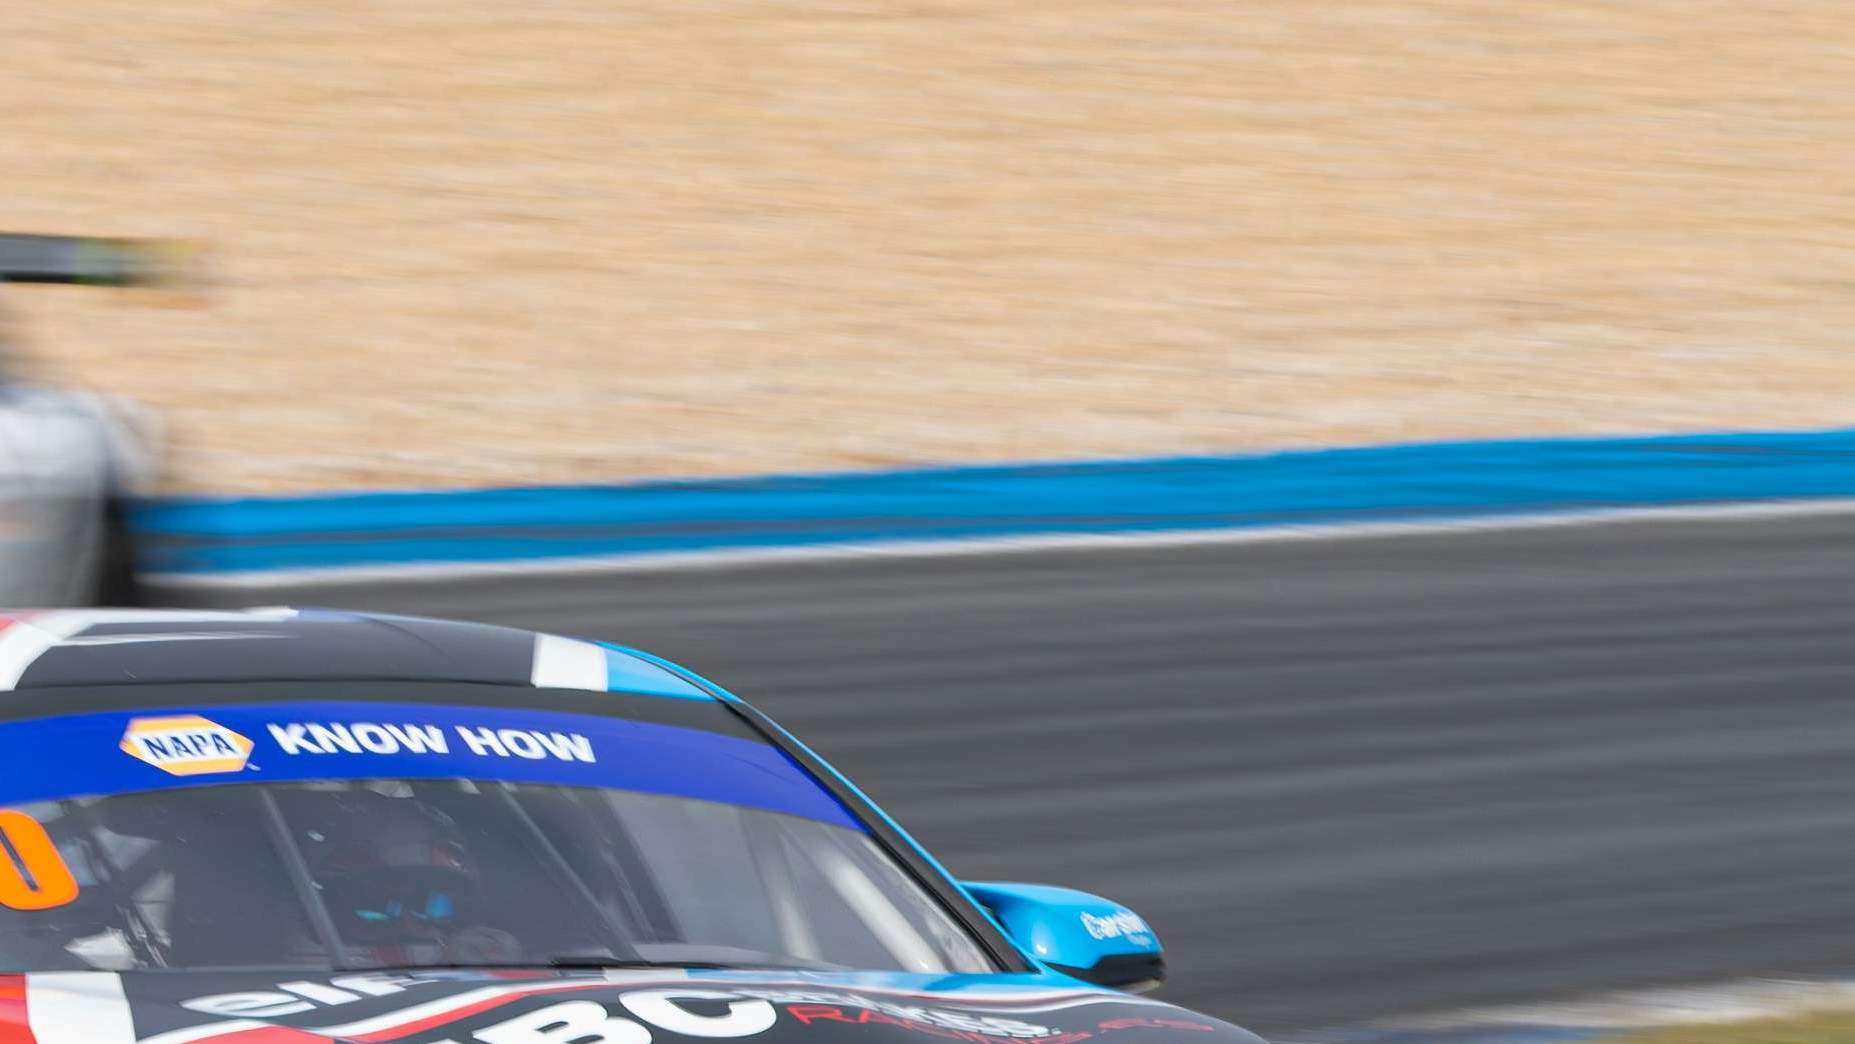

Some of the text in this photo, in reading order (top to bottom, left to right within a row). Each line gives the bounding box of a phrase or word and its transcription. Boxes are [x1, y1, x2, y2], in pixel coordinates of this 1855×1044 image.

[142, 732, 236, 760] NAPA
[267, 722, 597, 763] KNOW HOW
